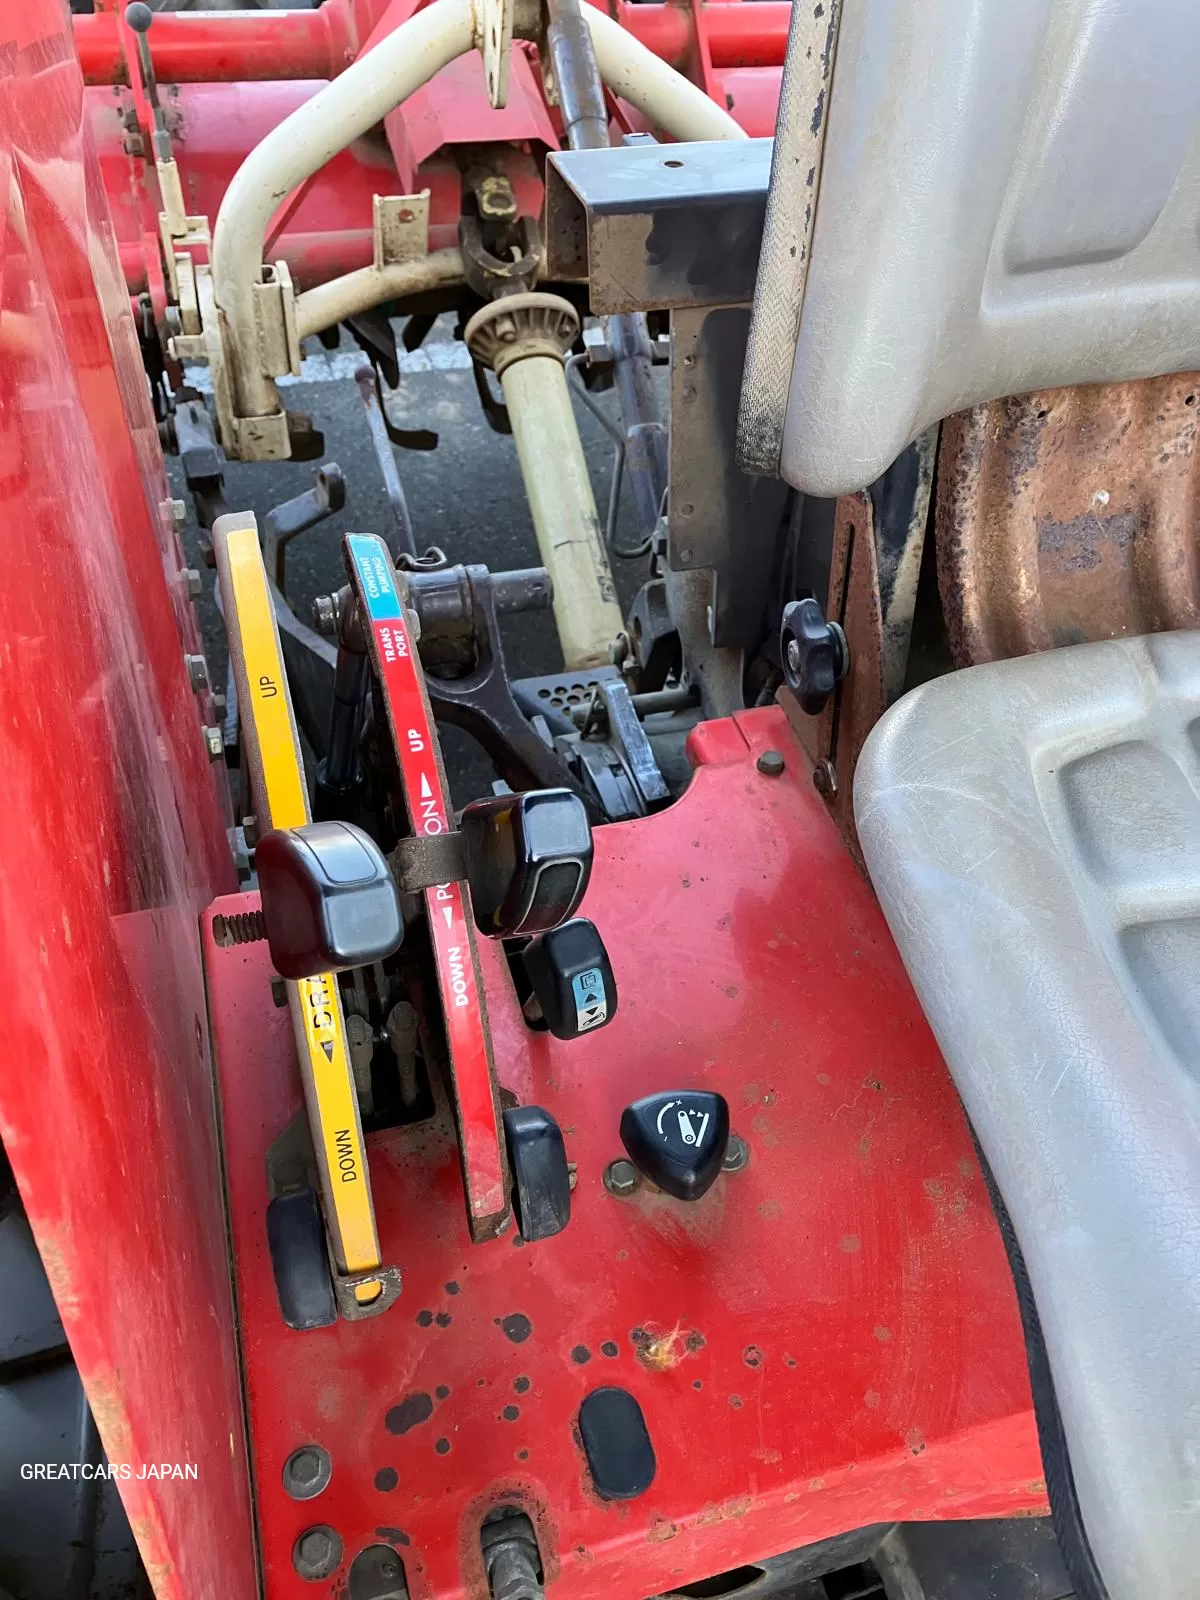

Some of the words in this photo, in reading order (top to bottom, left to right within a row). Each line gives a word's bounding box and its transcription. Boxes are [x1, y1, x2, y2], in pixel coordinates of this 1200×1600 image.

[379, 627, 397, 663] TRANS
[393, 630, 409, 657] PORT
[259, 676, 278, 698] UP
[407, 728, 425, 753] UP
[447, 946, 469, 1007] DOWN
[334, 1129, 358, 1183] DOWN
